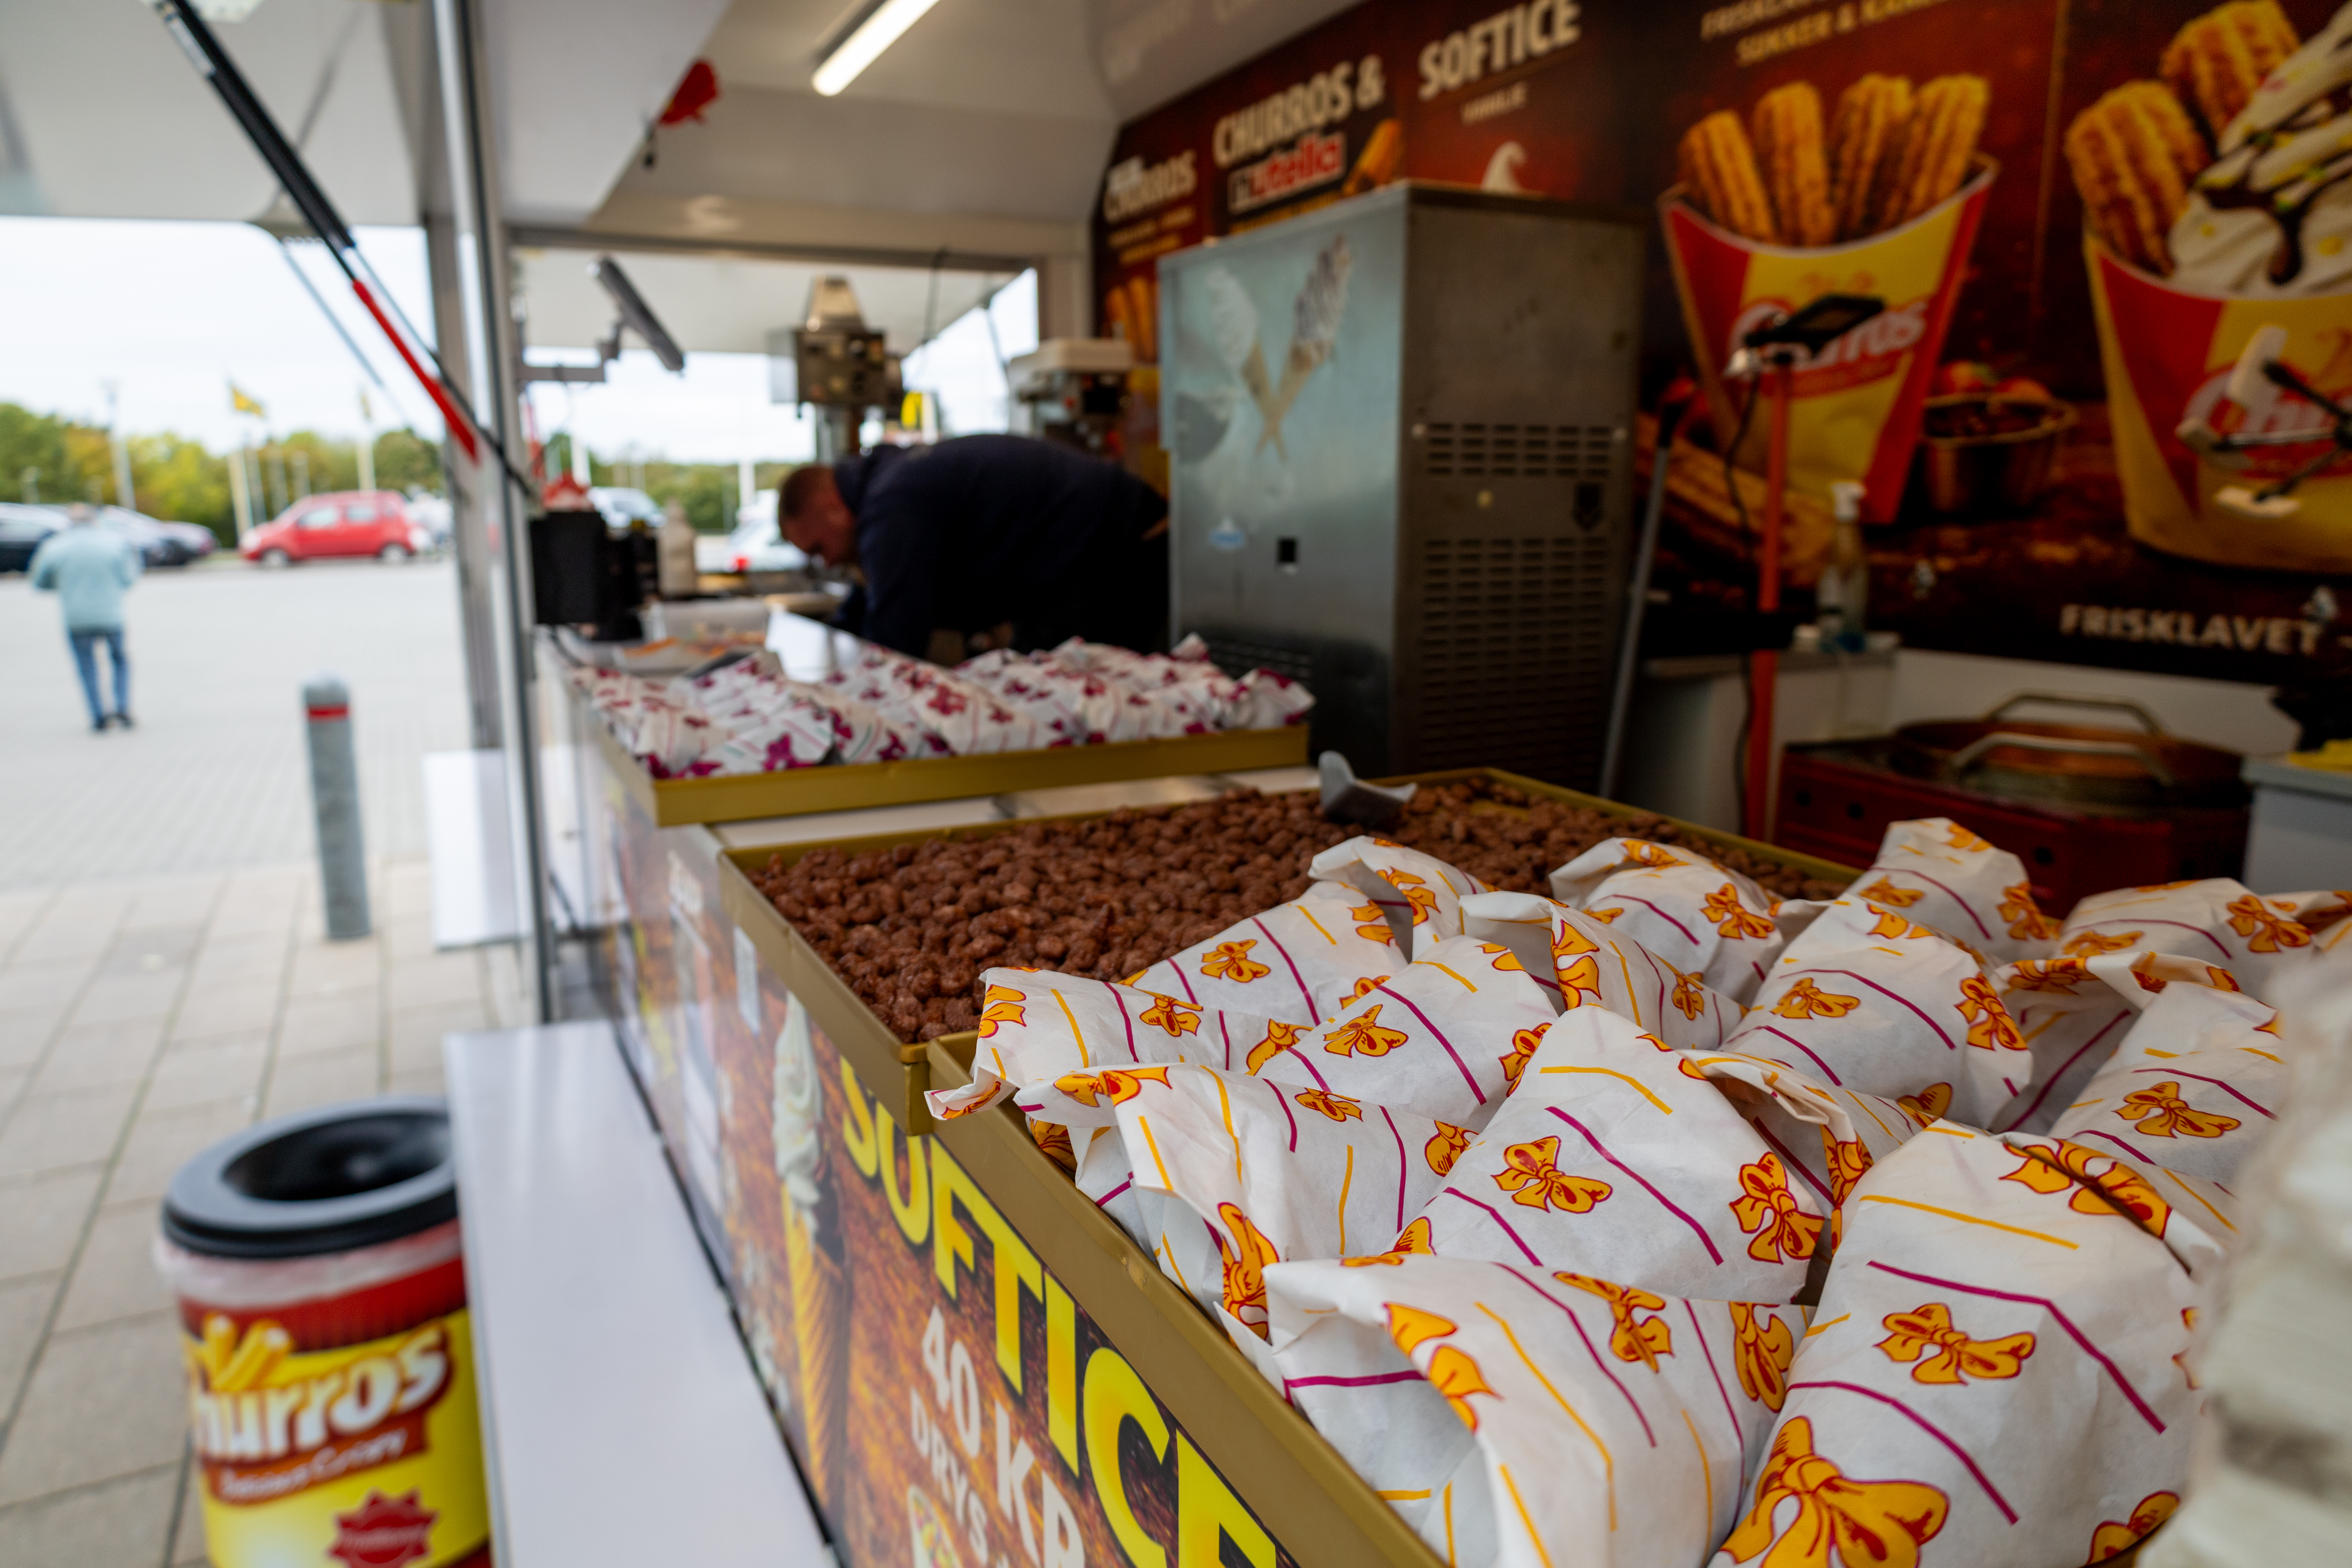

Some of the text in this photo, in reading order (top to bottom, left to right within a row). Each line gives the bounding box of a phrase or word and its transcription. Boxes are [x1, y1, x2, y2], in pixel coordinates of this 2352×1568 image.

[1418, 0, 1581, 100] SOFTICE
[1213, 55, 1384, 168] CHURROS &
[1232, 136, 1342, 208] nutella
[2058, 604, 2325, 658] FRISKLAVET
[921, 1303, 981, 1460] 40
[910, 1385, 989, 1566] DRYS
